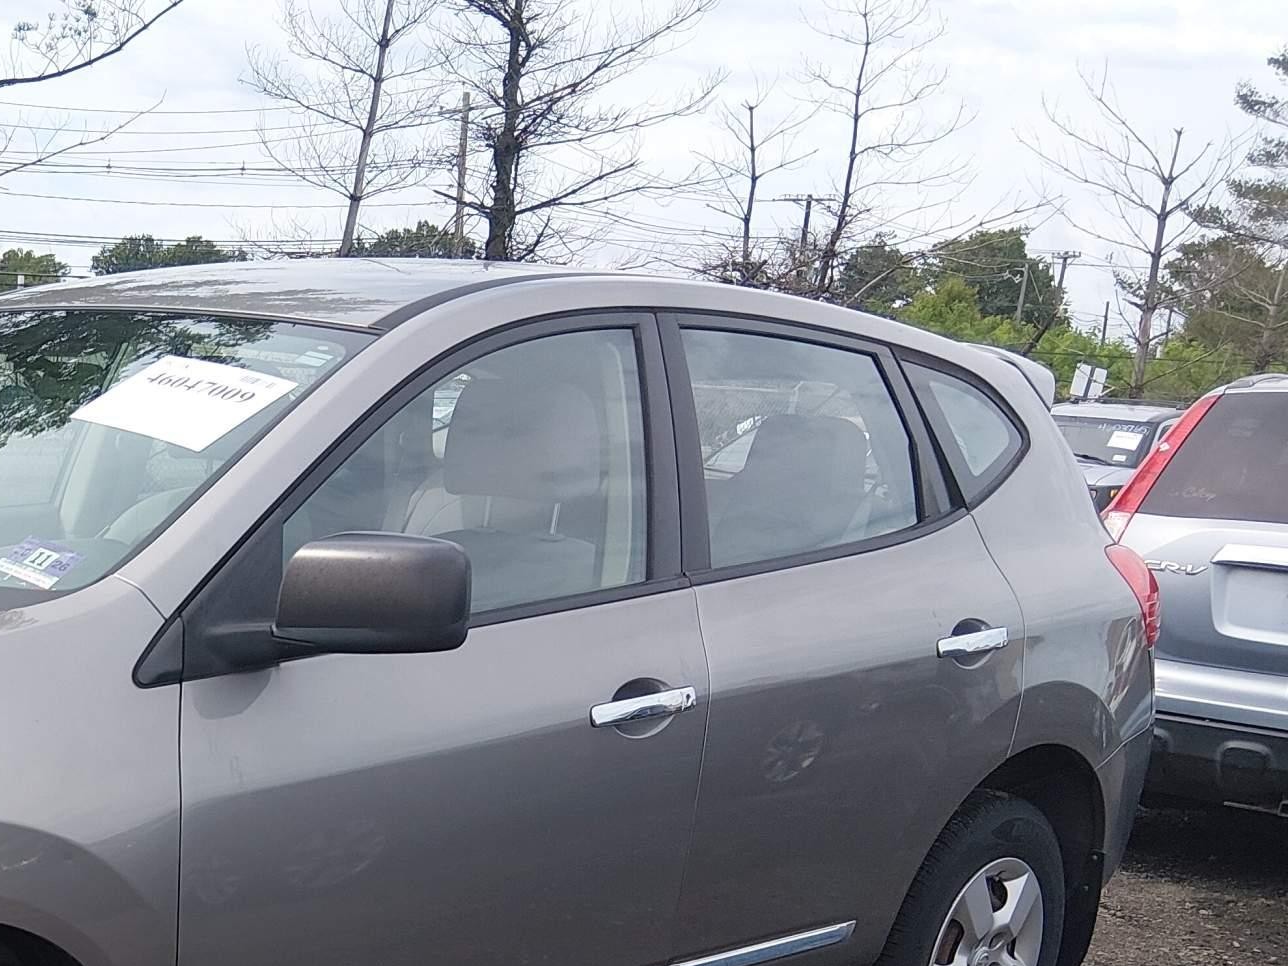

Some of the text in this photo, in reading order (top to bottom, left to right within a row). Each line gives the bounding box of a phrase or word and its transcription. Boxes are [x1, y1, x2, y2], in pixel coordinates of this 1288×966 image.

[147, 371, 257, 403] 46047009
[28, 551, 53, 567] 11
[1144, 560, 1209, 575] CR-V
